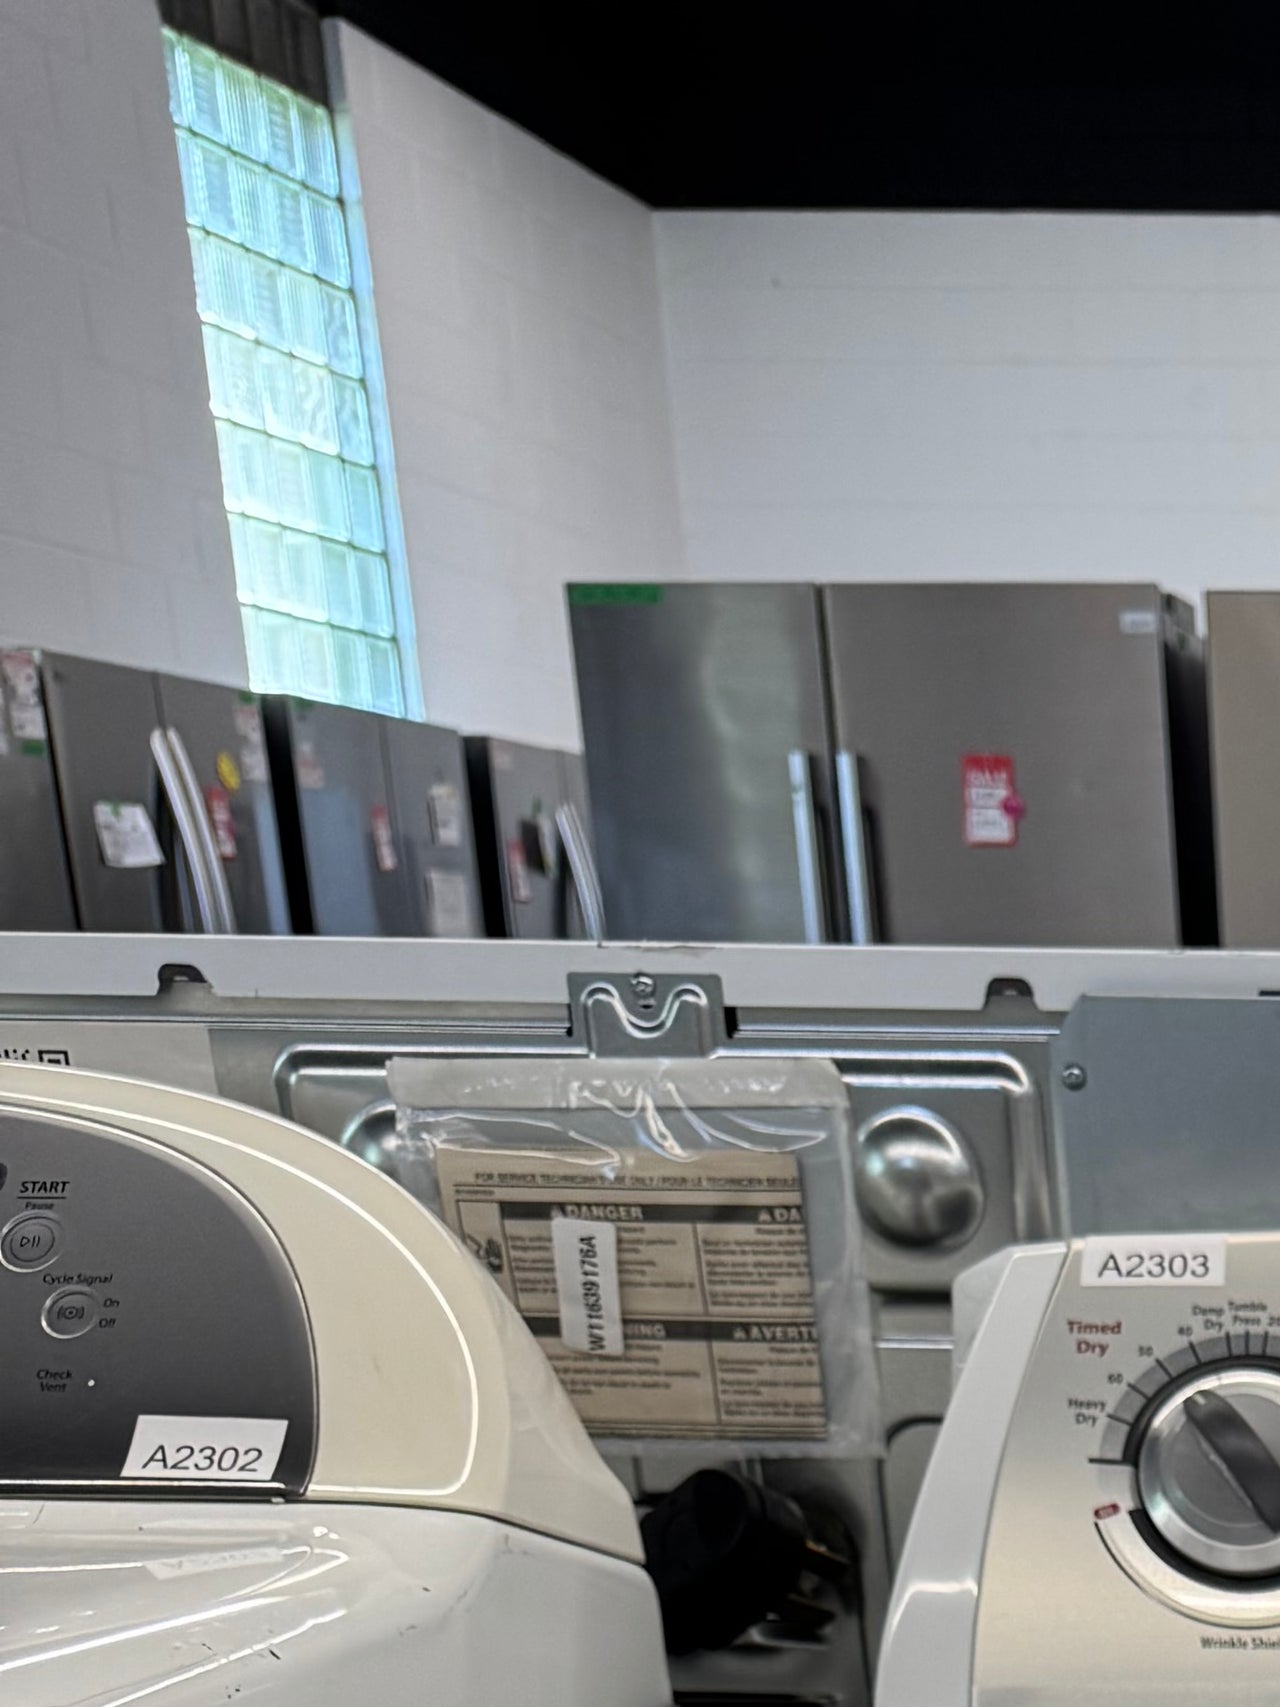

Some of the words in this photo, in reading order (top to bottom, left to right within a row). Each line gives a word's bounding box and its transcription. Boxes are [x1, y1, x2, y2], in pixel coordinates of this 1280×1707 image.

[20, 1181, 70, 1194] START
[565, 1205, 643, 1220] DANGER
[1098, 1253, 1210, 1278] A2303
[43, 1273, 74, 1285] Cycle
[76, 1273, 113, 1286] Signal
[103, 1298, 120, 1308] On
[99, 1317, 116, 1329] Off
[1067, 1320, 1122, 1335] Timed
[1076, 1340, 1109, 1357] Dry
[37, 1369, 72, 1380] Check
[142, 1445, 263, 1472] A2302
[1201, 1637, 1250, 1650] Wrinkle
